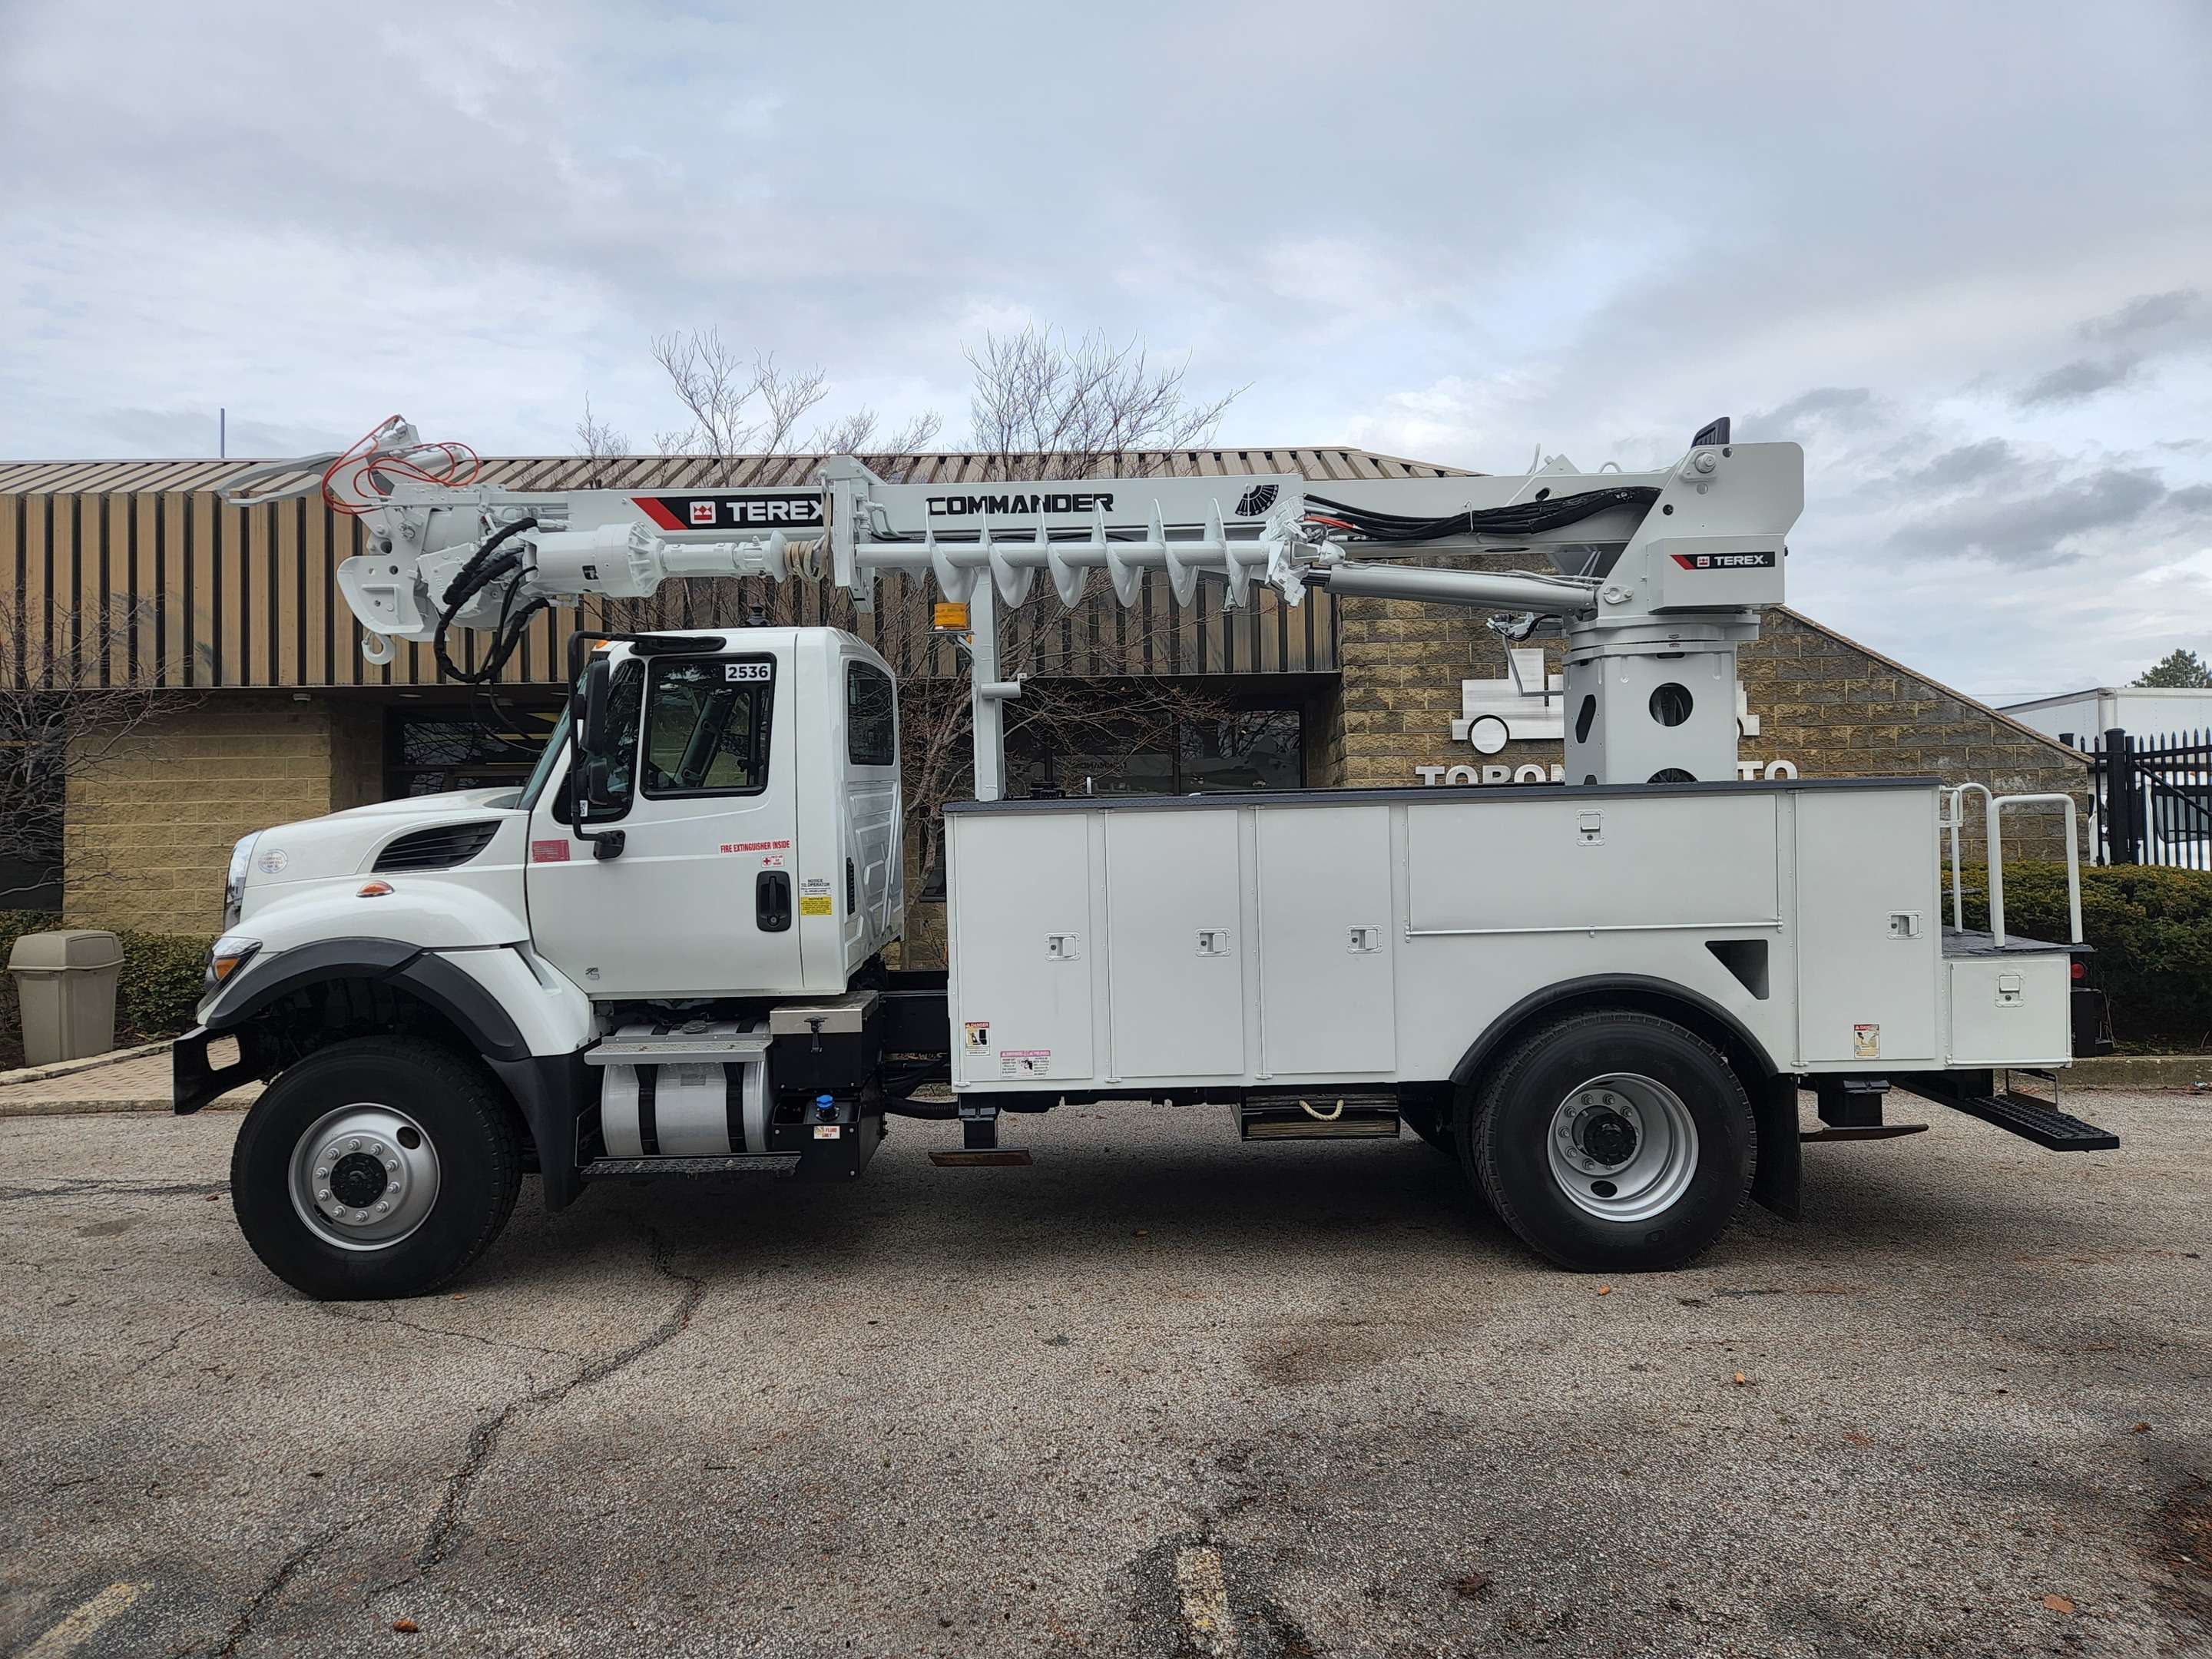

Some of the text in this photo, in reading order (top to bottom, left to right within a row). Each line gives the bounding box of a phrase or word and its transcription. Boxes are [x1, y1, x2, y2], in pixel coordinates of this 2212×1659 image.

[726, 500, 824, 522] TEREX
[926, 493, 1114, 515] COMMANDER
[727, 665, 769, 679] 2536
[720, 839, 790, 853] FIRE EXTINGUISHER INSIDE
